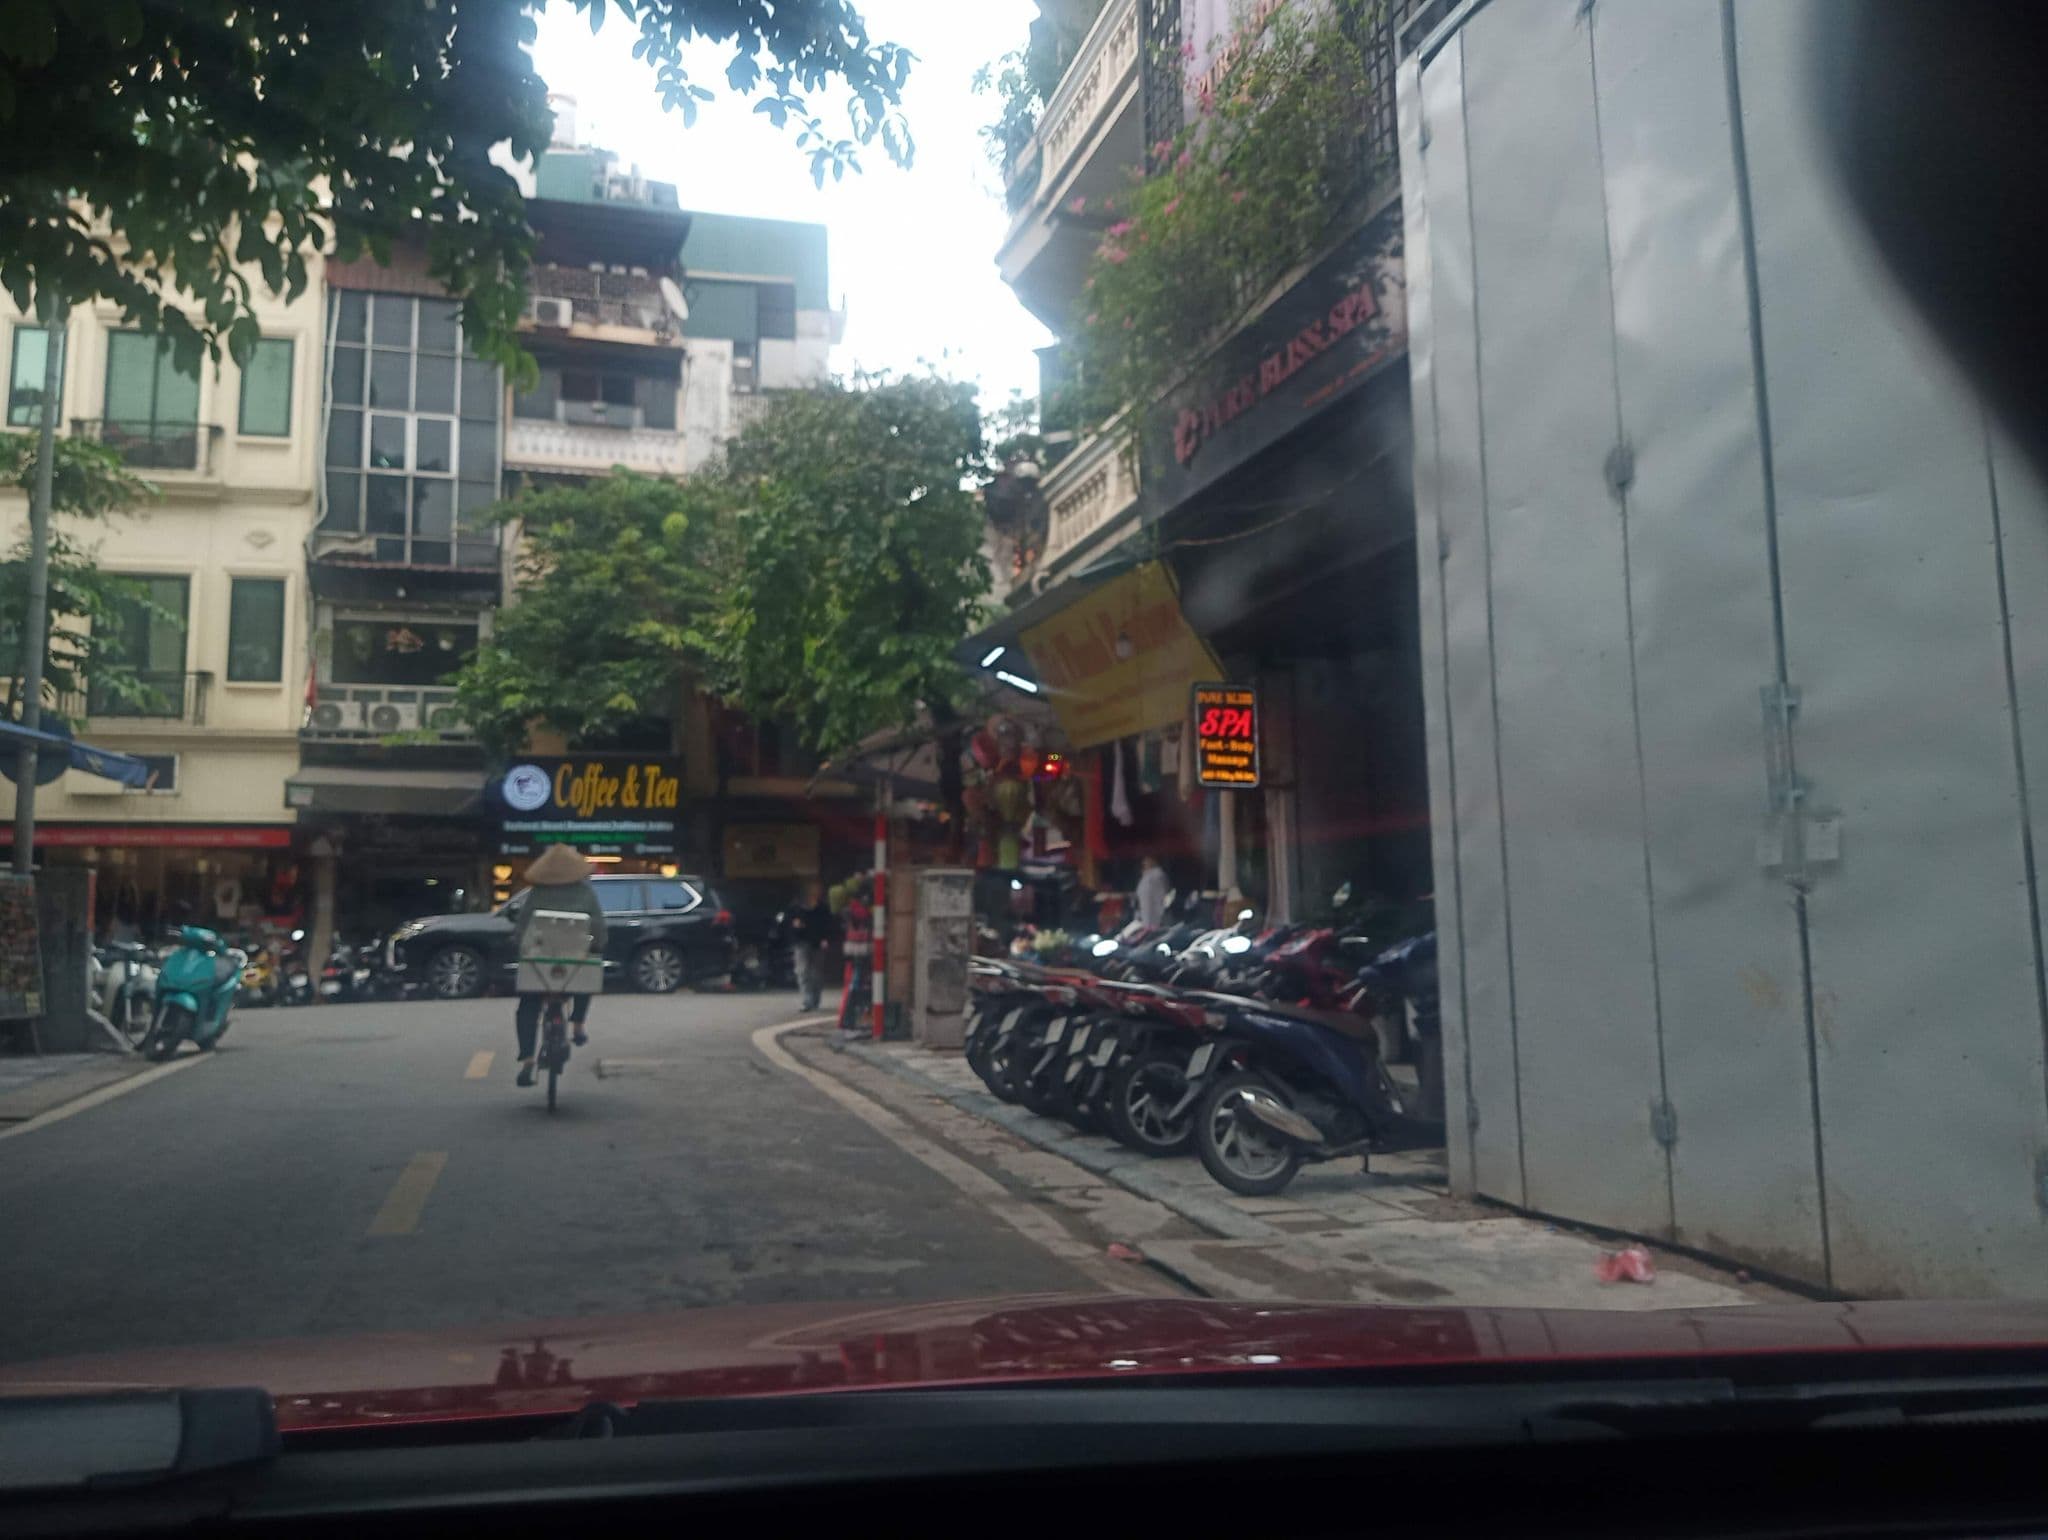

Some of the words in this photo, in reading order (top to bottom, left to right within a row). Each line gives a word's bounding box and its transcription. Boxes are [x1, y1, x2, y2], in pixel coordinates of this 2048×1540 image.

[1328, 283, 1376, 343] SPA
[1200, 708, 1251, 736] SPA
[554, 763, 619, 817] Coffee
[621, 764, 641, 808] &
[644, 765, 679, 809] Tea
